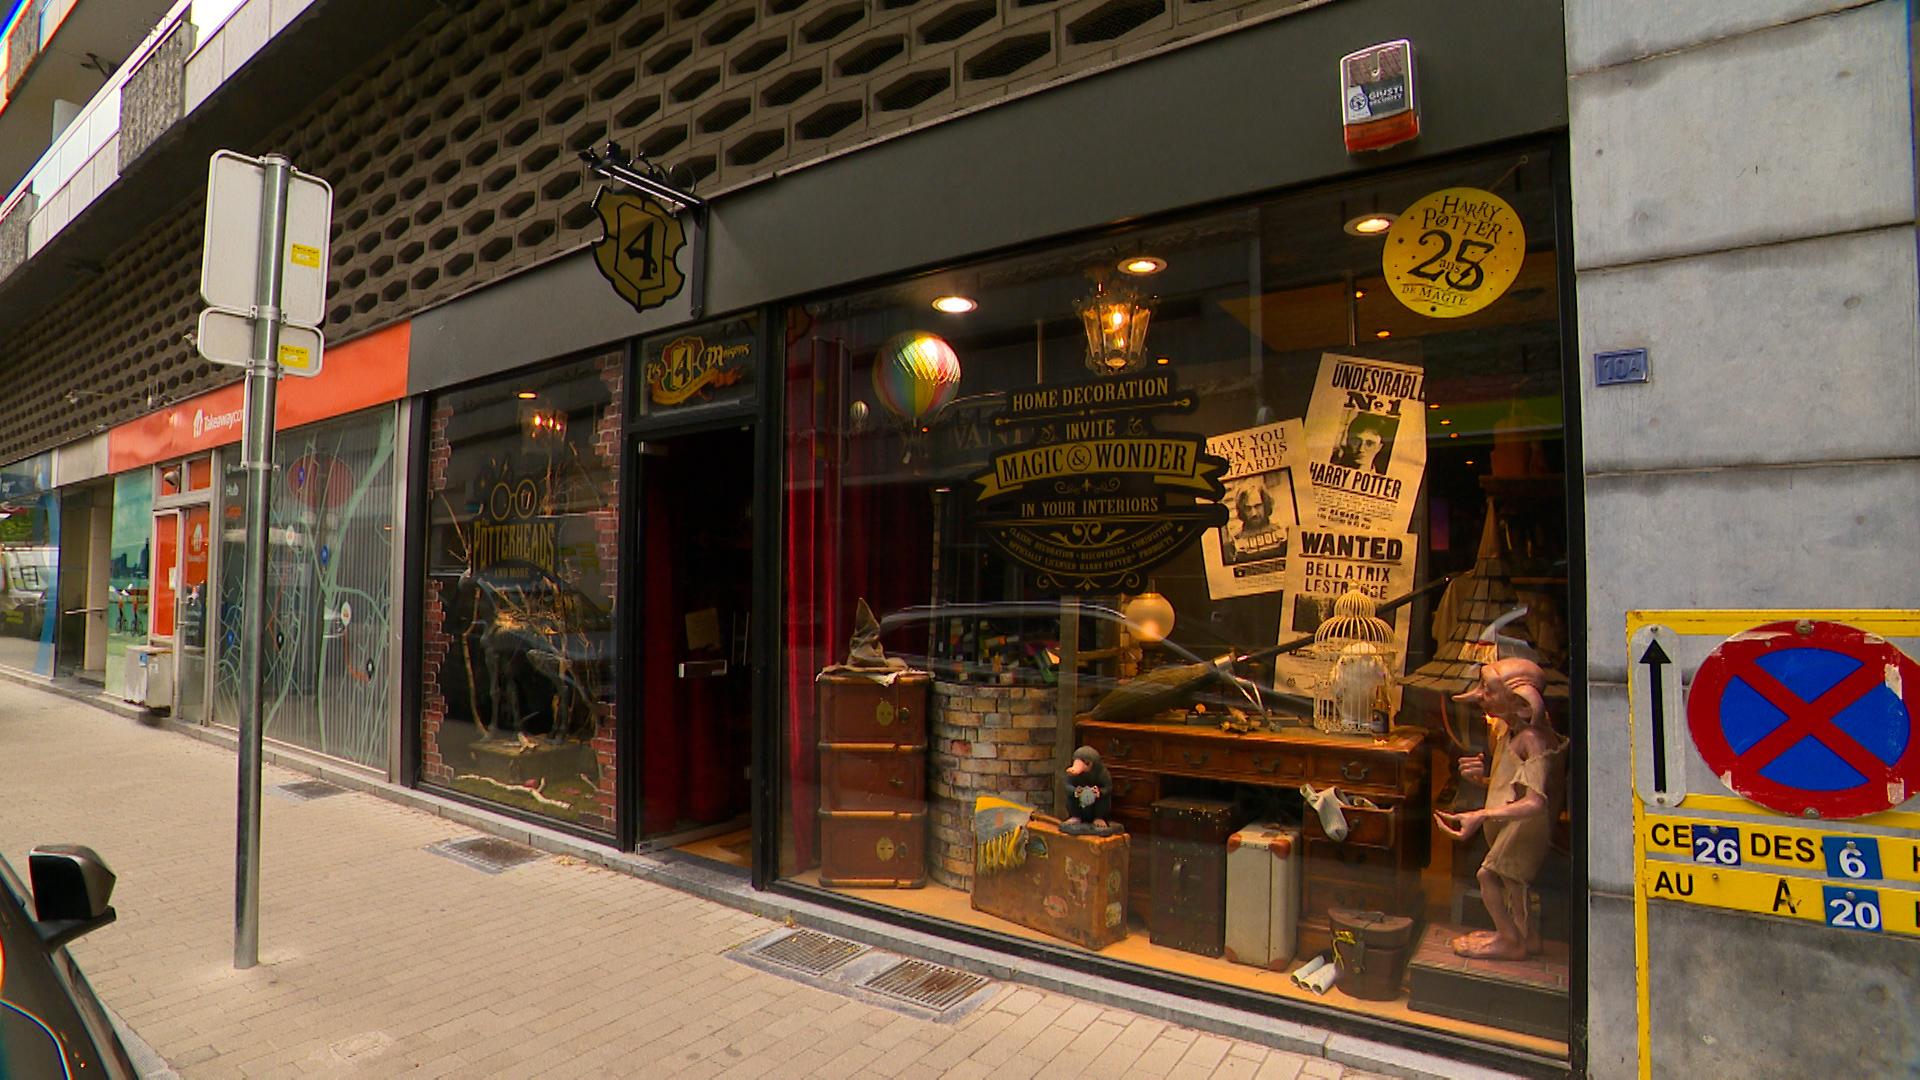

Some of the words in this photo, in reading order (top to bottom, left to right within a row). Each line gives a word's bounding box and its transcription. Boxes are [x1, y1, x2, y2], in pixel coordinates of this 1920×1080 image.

[1440, 194, 1503, 221] HARRY
[1421, 207, 1502, 243] POTTER
[623, 221, 658, 281] 4
[1406, 228, 1495, 292] 25
[1439, 258, 1462, 274] ans
[1419, 287, 1468, 306] MAGIE
[673, 346, 690, 386] 4
[1012, 387, 1058, 412] HOME
[1062, 377, 1169, 407] DECORATION
[204, 408, 244, 431] Takeaway.co
[1065, 418, 1116, 441] INVITE
[1249, 441, 1288, 458] THIS
[1250, 427, 1286, 446] YOU
[1001, 447, 1065, 483] MAGIC
[1095, 441, 1188, 472] WONDER
[1229, 455, 1283, 476] IZARD?
[1310, 461, 1351, 487] HARRY
[1352, 470, 1402, 499] POTTER
[1021, 503, 1035, 518] IN
[1042, 500, 1075, 517] YOUR
[1082, 497, 1159, 514] INTERIORS
[472, 519, 556, 576] POTTERHEADS
[1301, 531, 1403, 561] WANTED
[1305, 561, 1391, 584] BELLATRIX
[1304, 577, 1389, 600] LESTRNGE
[1651, 823, 1691, 848] CE
[1694, 837, 1739, 865] 26
[1750, 832, 1816, 863] DES
[1839, 847, 1866, 878] 6
[1654, 871, 1694, 896] AU
[1772, 878, 1797, 914] A
[1829, 898, 1880, 930] 20
